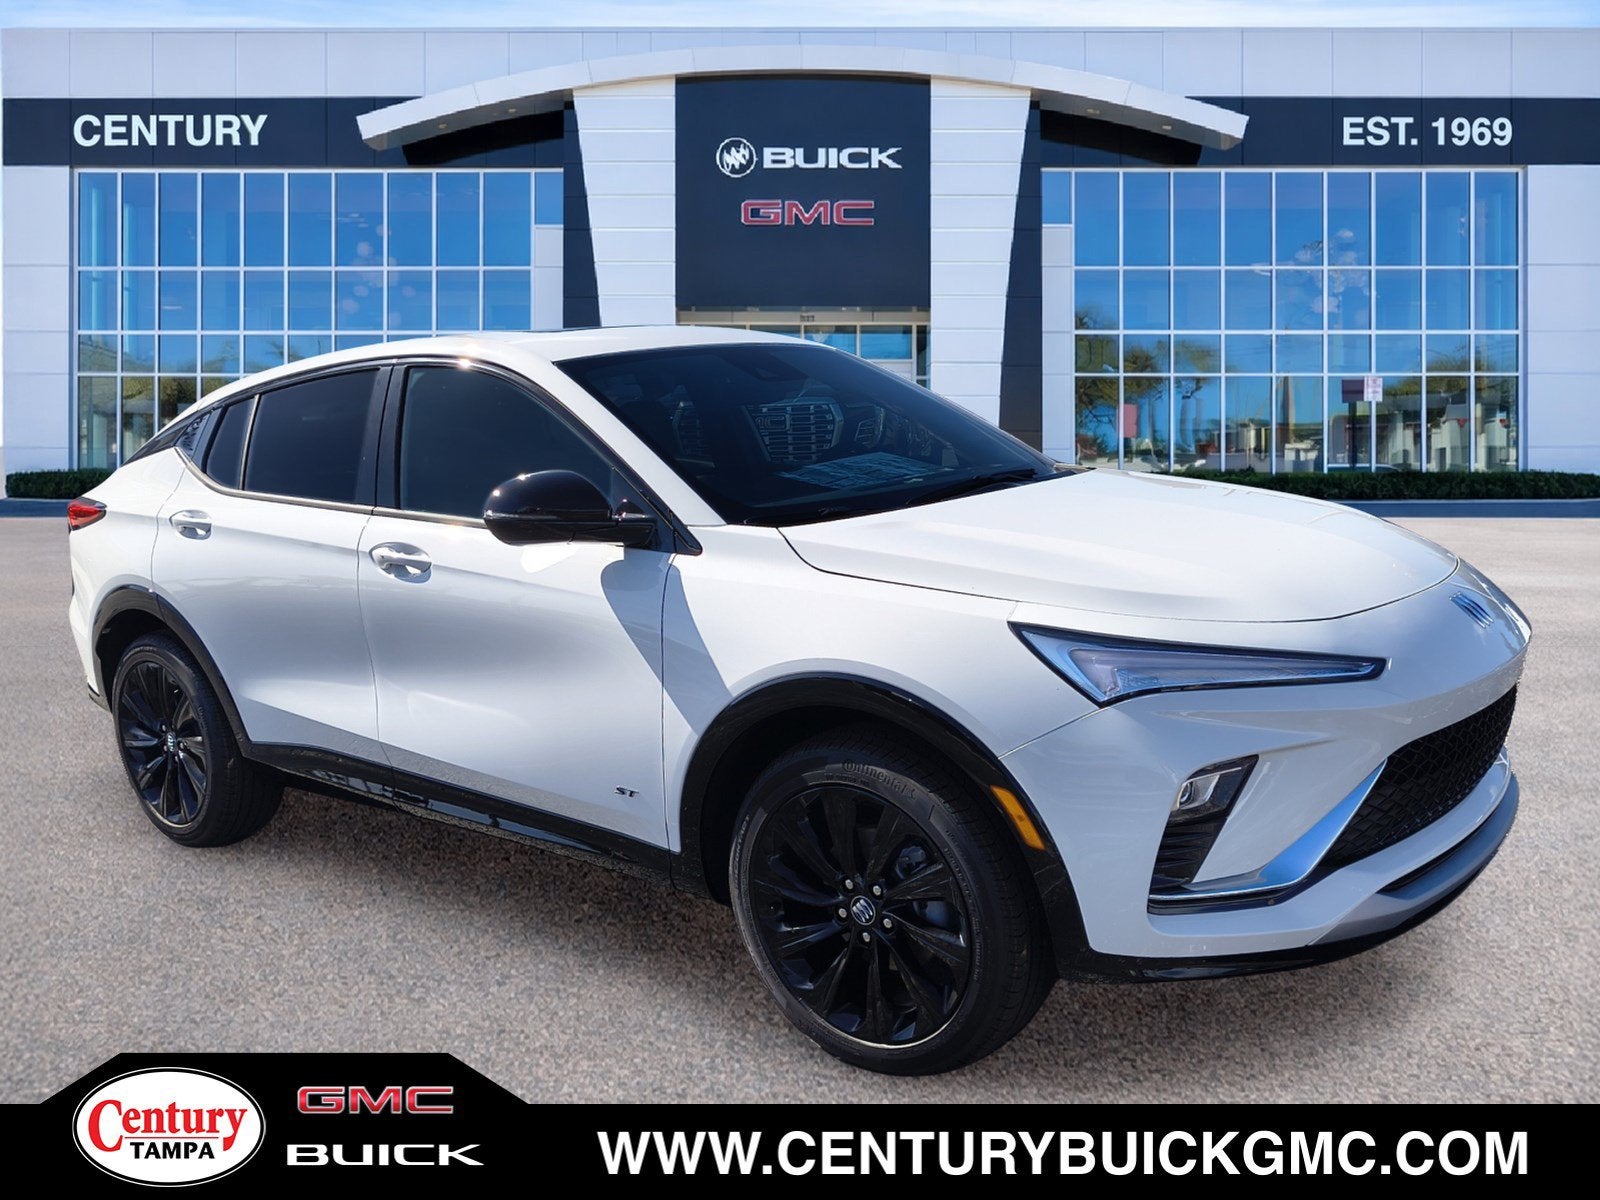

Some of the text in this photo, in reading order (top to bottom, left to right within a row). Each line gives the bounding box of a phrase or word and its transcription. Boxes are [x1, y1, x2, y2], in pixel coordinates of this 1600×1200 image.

[73, 114, 268, 147] CENTURY
[1342, 115, 1513, 147] EST. 1969
[762, 147, 903, 169] BUICK
[740, 199, 875, 226] GMC
[614, 786, 639, 798] ST
